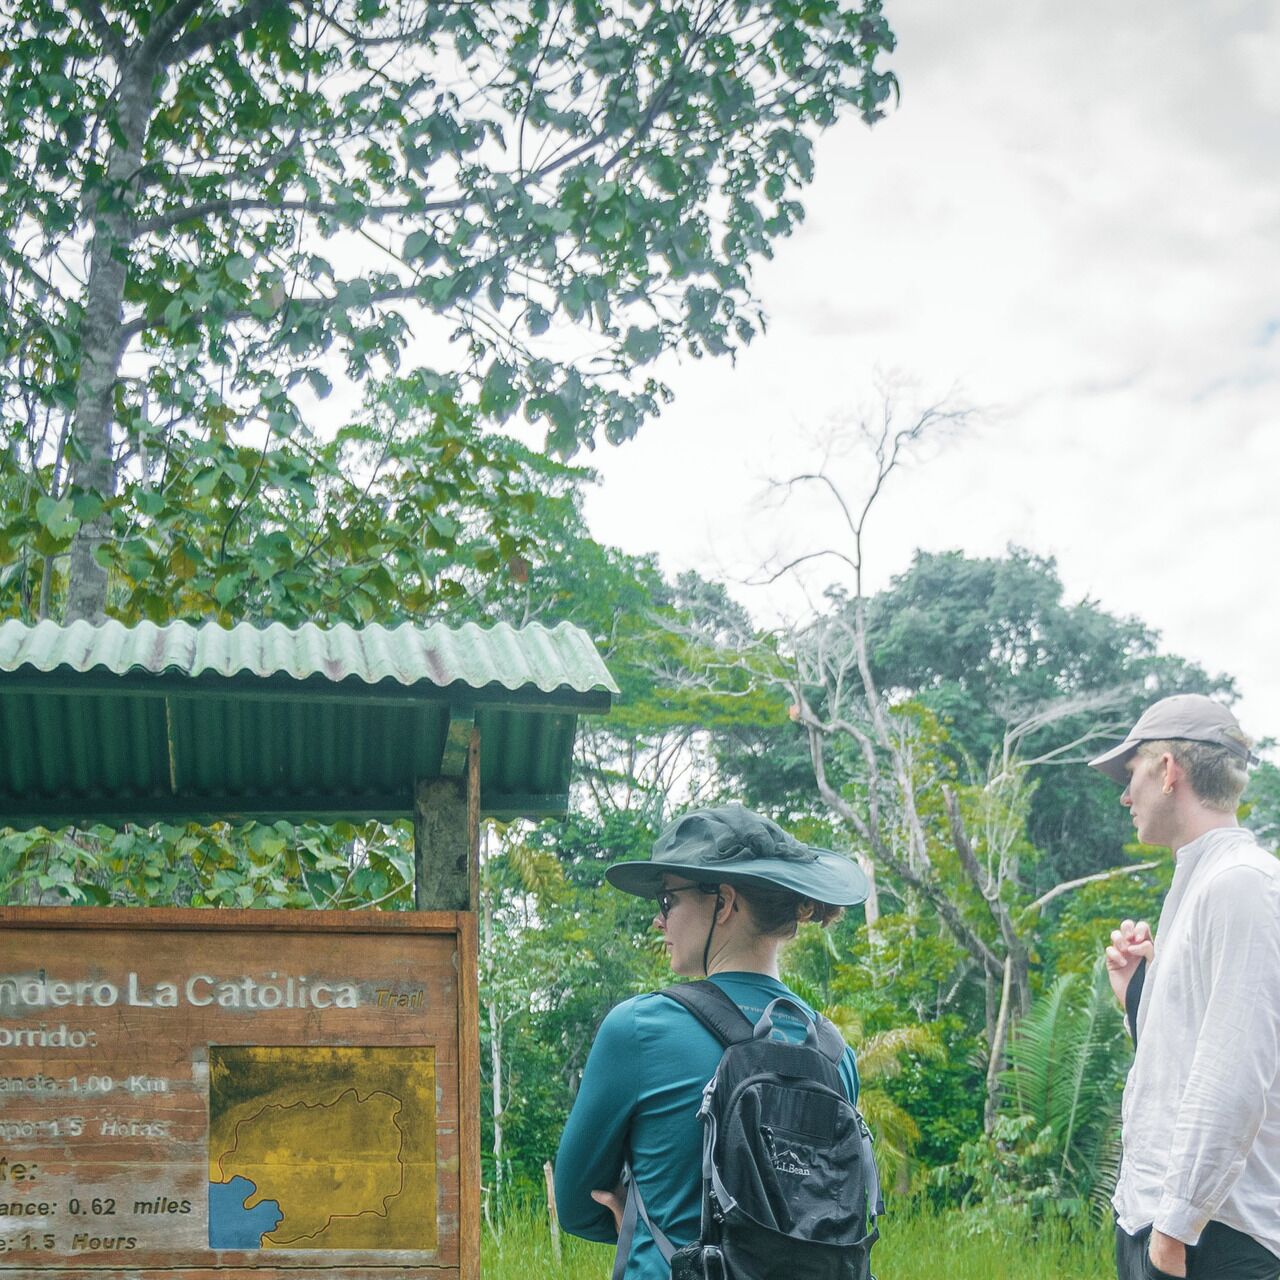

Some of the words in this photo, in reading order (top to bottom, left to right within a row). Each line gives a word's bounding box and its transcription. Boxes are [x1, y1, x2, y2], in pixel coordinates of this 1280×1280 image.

[128, 971, 178, 1007] La
[185, 972, 358, 1009] Católica
[375, 988, 424, 1009] Trail
[130, 1075, 168, 1093] Km
[100, 1119, 167, 1137] Horas
[69, 1198, 117, 1216] 0.62
[132, 1197, 193, 1215] miles
[21, 1234, 56, 1252] 1.5
[71, 1233, 138, 1251] Hours
